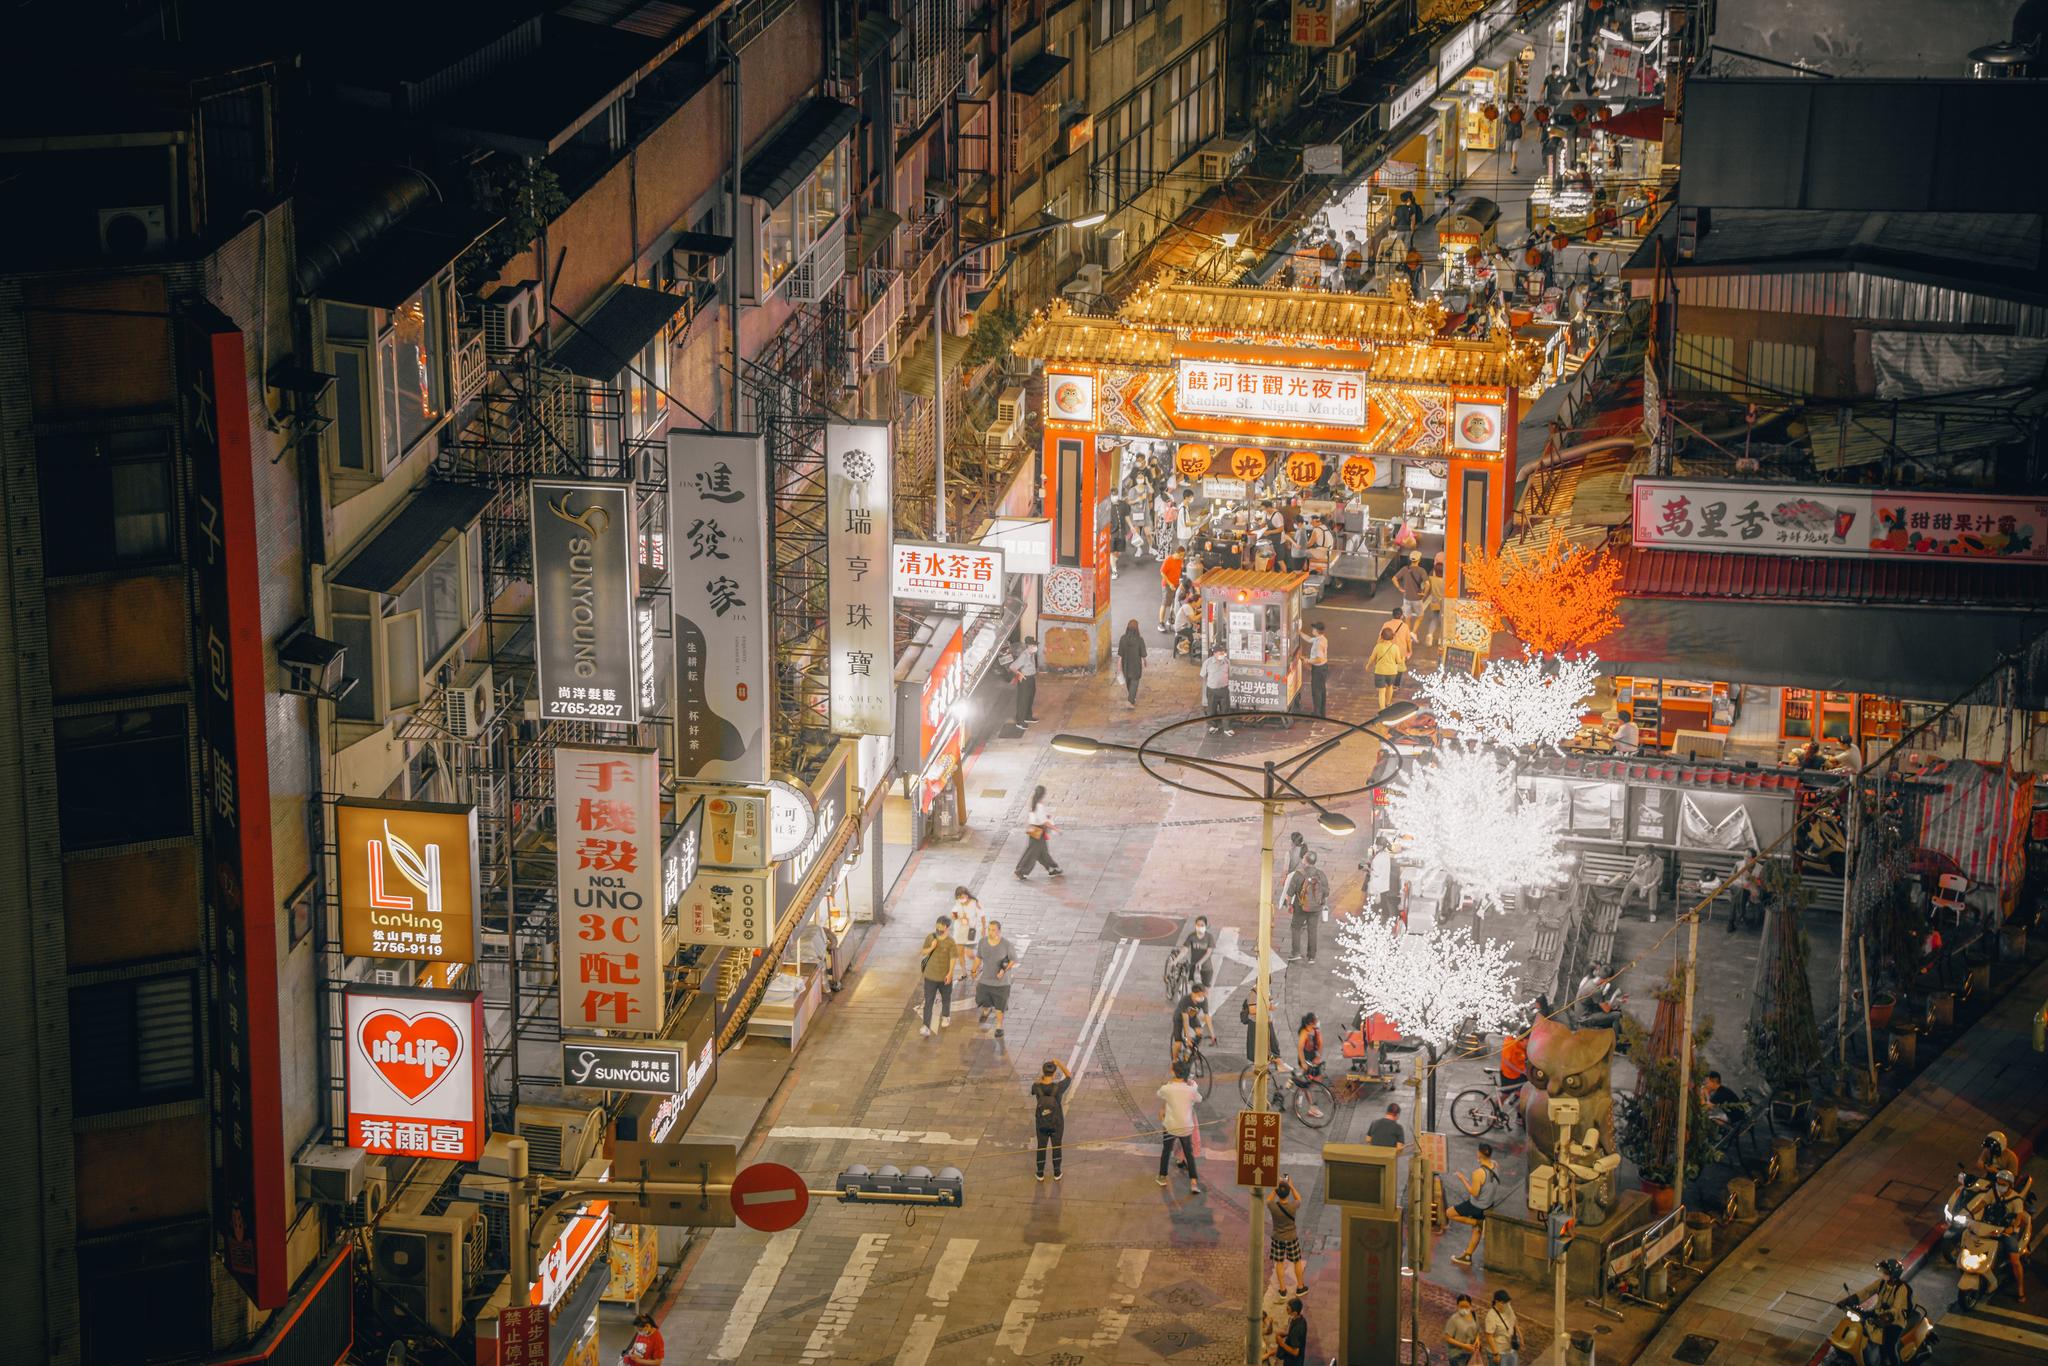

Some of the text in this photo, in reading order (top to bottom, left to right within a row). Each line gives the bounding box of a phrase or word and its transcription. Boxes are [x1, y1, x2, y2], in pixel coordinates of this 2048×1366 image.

[1187, 370, 1359, 401] 饒河街觀光夜市
[1186, 393, 1361, 417] Raohe St. Night Market
[1656, 494, 1772, 541] 萬里香
[1909, 510, 2018, 535] 甜甜果汁霸
[686, 461, 746, 618] 進發家
[899, 550, 994, 582] 清水茶香
[567, 536, 598, 680] SUNYOUNG
[844, 507, 874, 678] 瑞亨珠寶
[550, 700, 623, 717] 2765-2827
[574, 760, 639, 874] 手機殼
[588, 875, 626, 889] NO.1
[573, 887, 644, 911] UNO
[372, 929, 443, 945] 松山門市部
[577, 913, 641, 944] 3C
[372, 941, 444, 956] 2756-9119
[579, 952, 641, 1025] 配件
[594, 1065, 671, 1084] SUNYOUNG
[360, 1119, 465, 1155] 萊爾富
[1242, 1113, 1258, 1166] 錫口碼頭
[1261, 1114, 1277, 1168] 彩虹橋
[504, 1310, 523, 1366] 禁止停
